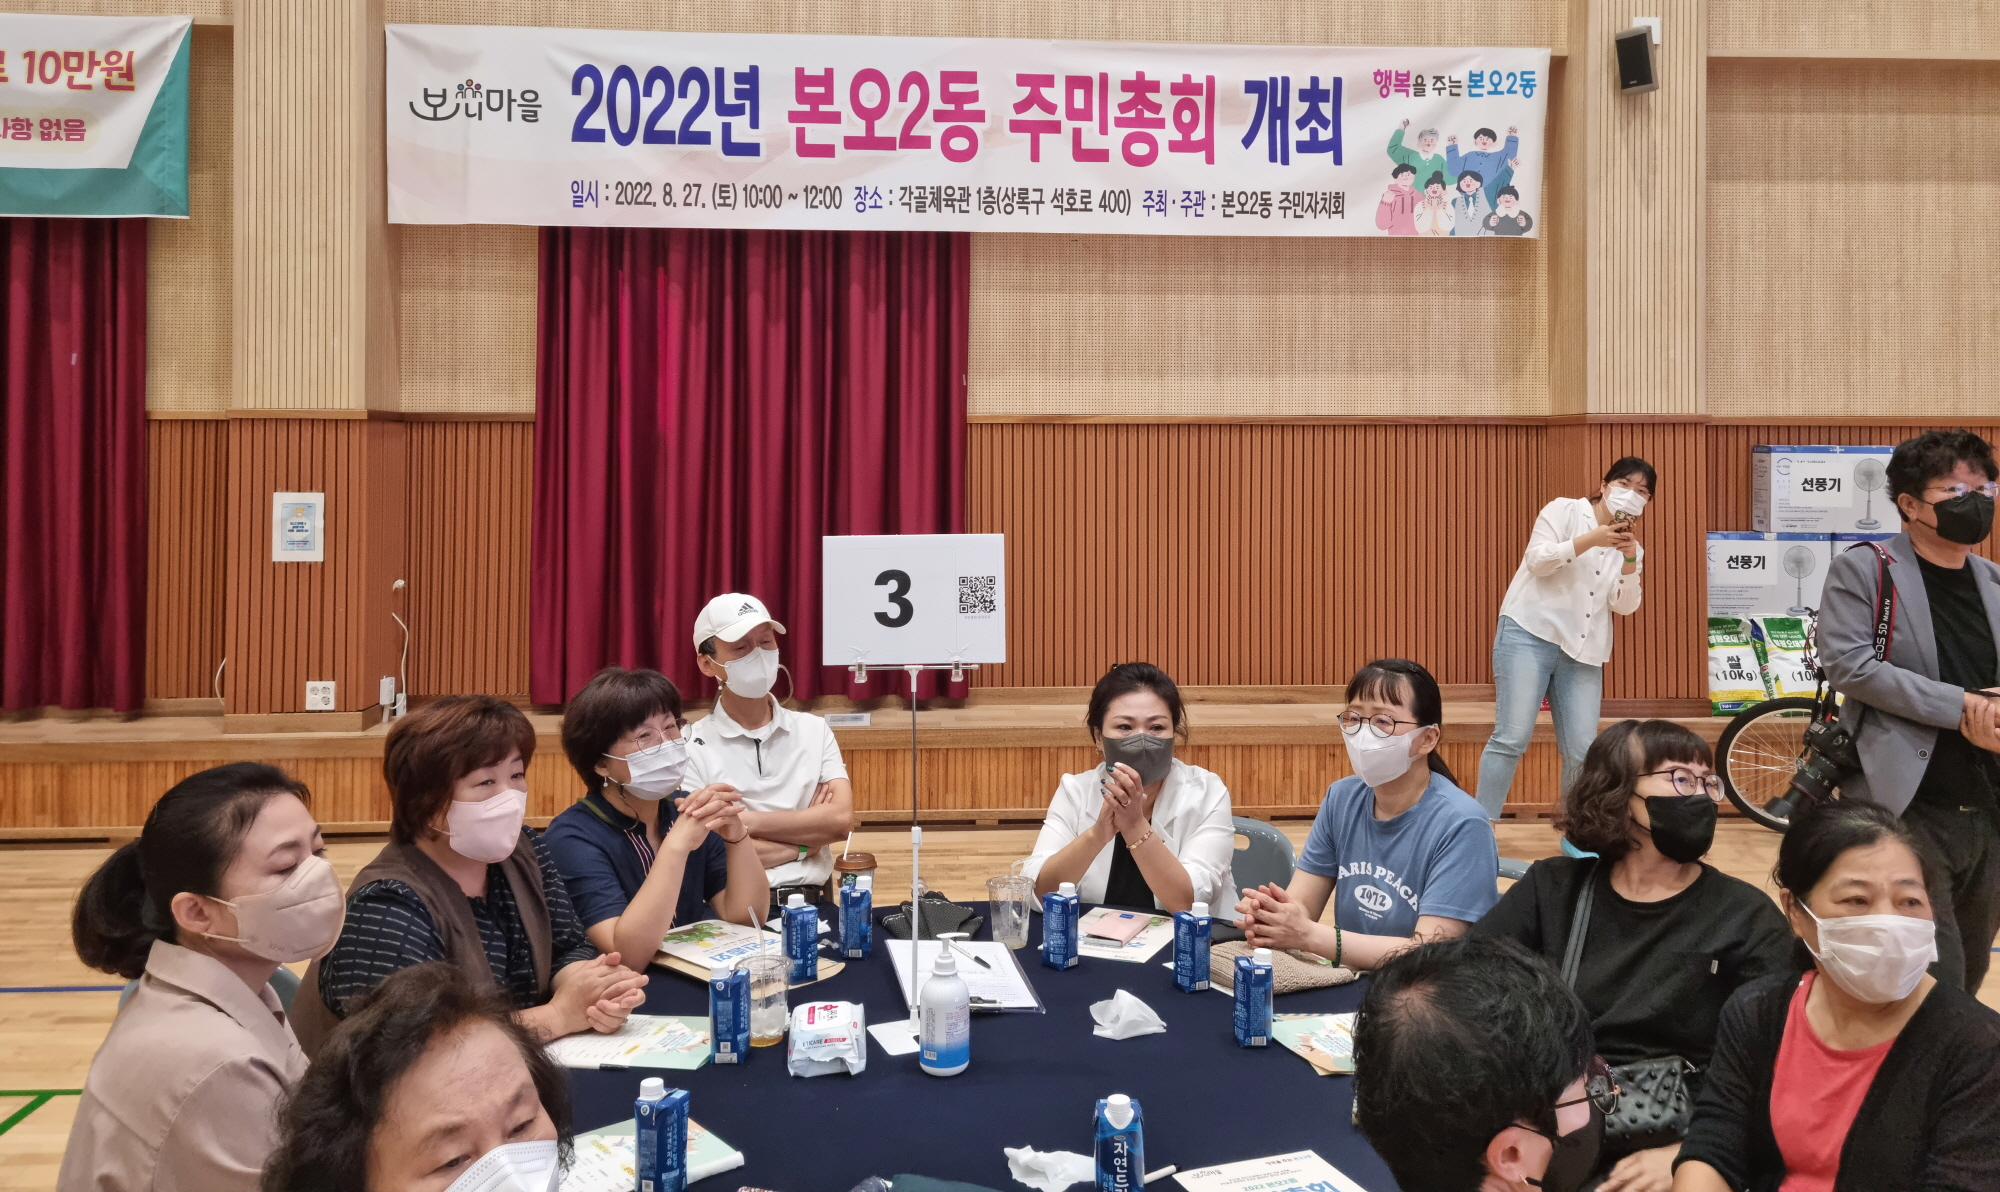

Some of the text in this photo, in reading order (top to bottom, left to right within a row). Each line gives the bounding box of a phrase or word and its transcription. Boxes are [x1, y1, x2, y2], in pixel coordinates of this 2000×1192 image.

[23, 50, 135, 91] 10만원
[1373, 69, 1537, 98] 행복을 주는 본오2동
[570, 63, 1344, 167] 2022년 본오2동 주민총회 개최
[39, 118, 86, 141] 없음
[571, 180, 599, 208] 일시
[615, 181, 657, 207] 2022.
[663, 182, 677, 207] 8.
[683, 183, 706, 208] 27.
[712, 183, 737, 210] (토)
[743, 184, 782, 208] 10:00
[803, 185, 842, 209] 12:00
[854, 186, 883, 213] 장소
[899, 185, 971, 213] 각골체육관
[976, 186, 1045, 216] 1층(상록구
[1050, 188, 1093, 216] 석호로
[1098, 188, 1131, 216] 400)
[1142, 189, 1167, 217] 주최
[1180, 189, 1206, 217] 주관
[1221, 190, 1273, 219] 본오2동
[1278, 190, 1345, 219] 주민자치회
[1801, 477, 1841, 493] 선풍기
[1726, 554, 1766, 570] 선풍기
[873, 569, 914, 628] 3
[1878, 623, 1888, 635] 5D
[1726, 655, 1742, 669] 쌀
[1715, 669, 1758, 682] (10Kg)
[1338, 861, 1372, 879] ARIS
[1360, 888, 1387, 908] 1972
[1113, 1141, 1129, 1192] 자연드
